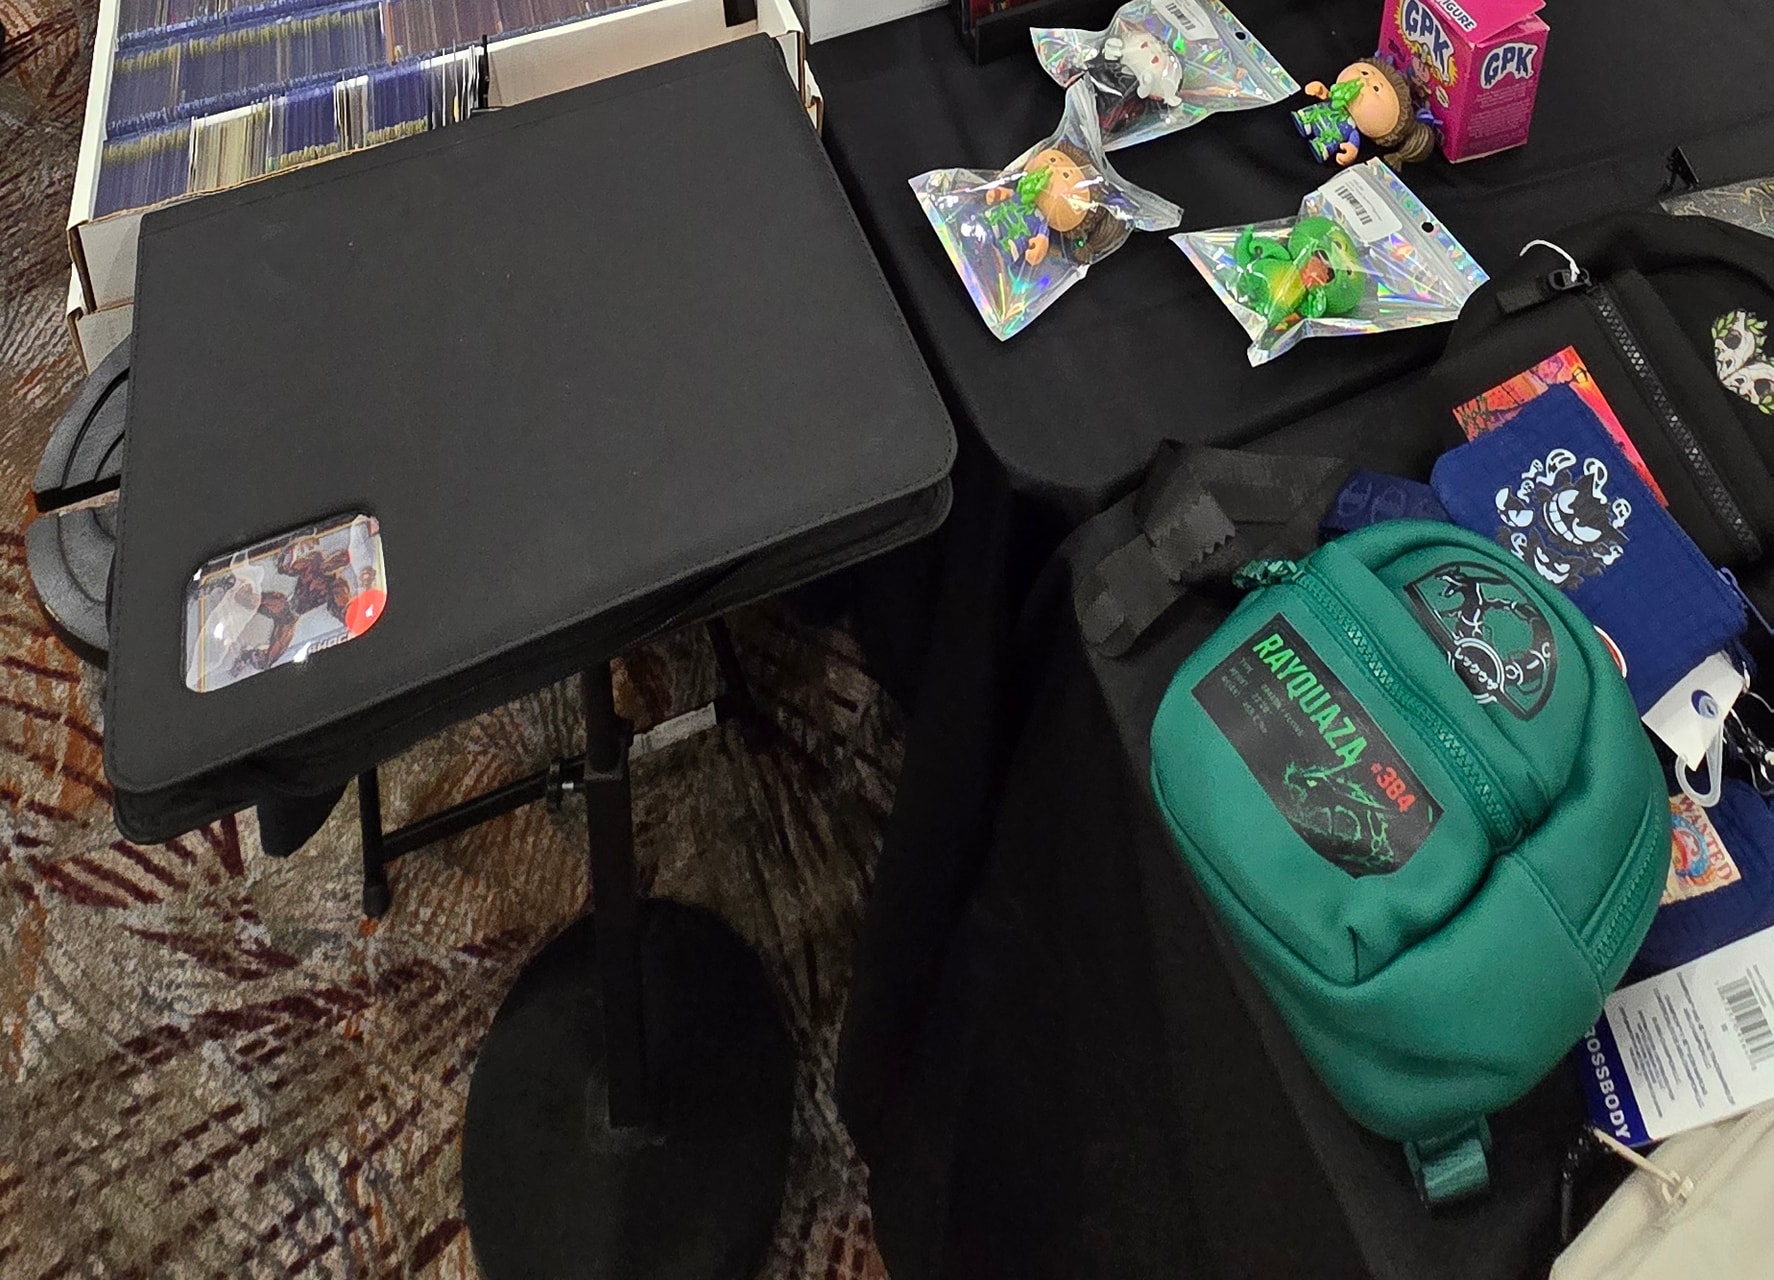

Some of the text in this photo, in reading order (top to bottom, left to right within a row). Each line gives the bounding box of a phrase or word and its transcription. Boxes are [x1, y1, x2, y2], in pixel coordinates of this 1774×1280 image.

[1404, 0, 1450, 74] GPK
[1484, 45, 1534, 87] GPK
[1252, 633, 1368, 768] RAYQUAZA
[1370, 761, 1417, 813] #384
[1679, 796, 1735, 882] WANTED
